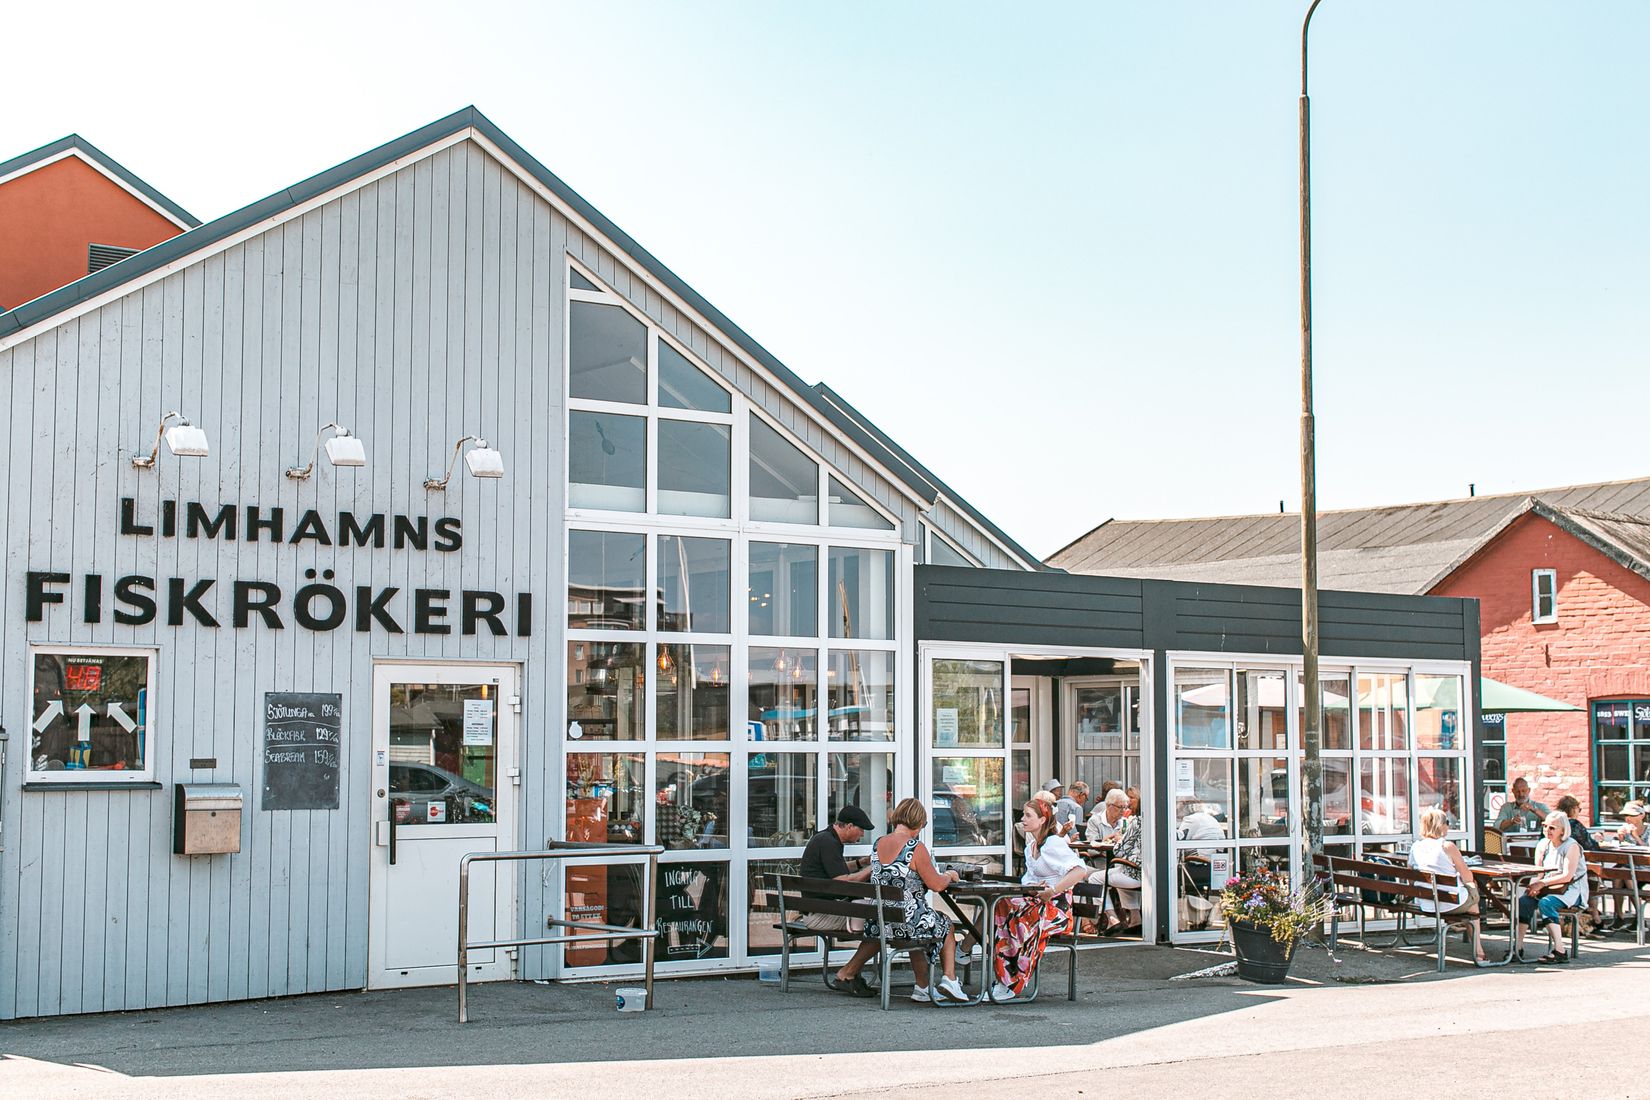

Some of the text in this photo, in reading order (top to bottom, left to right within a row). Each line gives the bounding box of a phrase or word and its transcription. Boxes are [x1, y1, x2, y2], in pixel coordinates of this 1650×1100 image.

[121, 498, 462, 552] LIMHAMNS
[26, 568, 532, 637] FISKRÖKERI
[665, 867, 698, 887] INGÅNG
[669, 895, 694, 909] TILL
[656, 917, 714, 938] RESTAURANGEN
